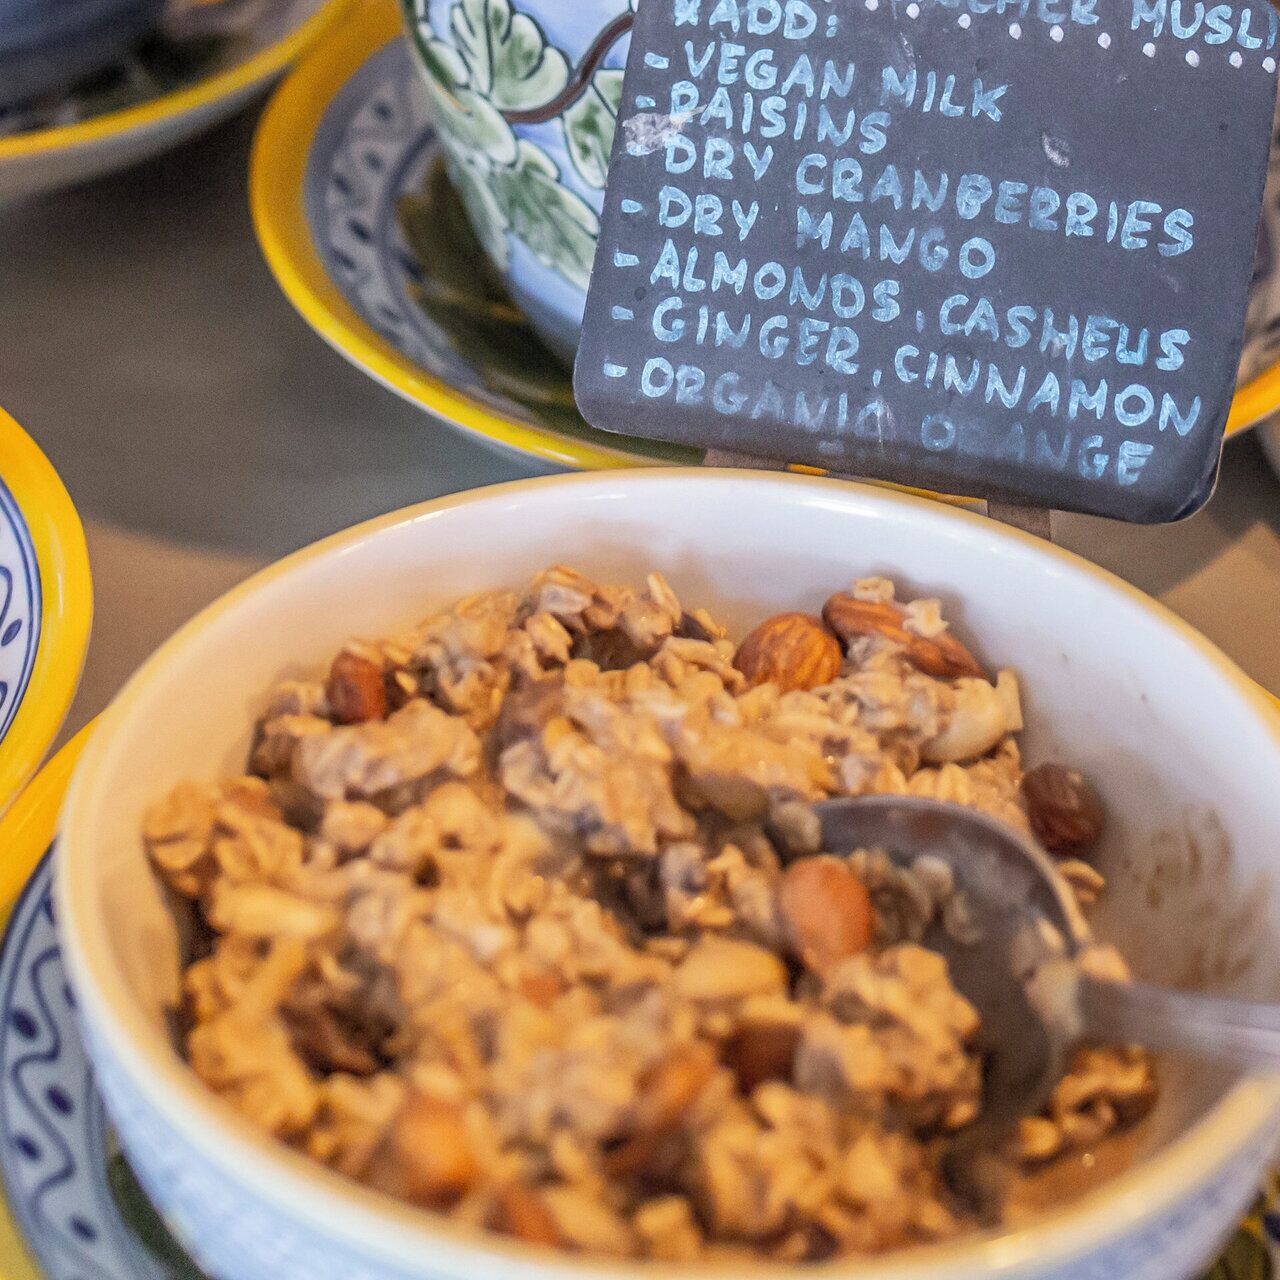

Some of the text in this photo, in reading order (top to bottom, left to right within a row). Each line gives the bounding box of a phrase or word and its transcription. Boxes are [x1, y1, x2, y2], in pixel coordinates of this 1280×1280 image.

[670, 80, 891, 154] RAISINS
[684, 40, 856, 99] VEGAN
[879, 65, 1012, 122] MILK
[658, 185, 760, 241] DRY
[796, 206, 996, 279] MANGO
[665, 133, 774, 181] DRY
[795, 153, 1194, 257] CRANBERRIES
[894, 344, 1202, 436] CINNAMON
